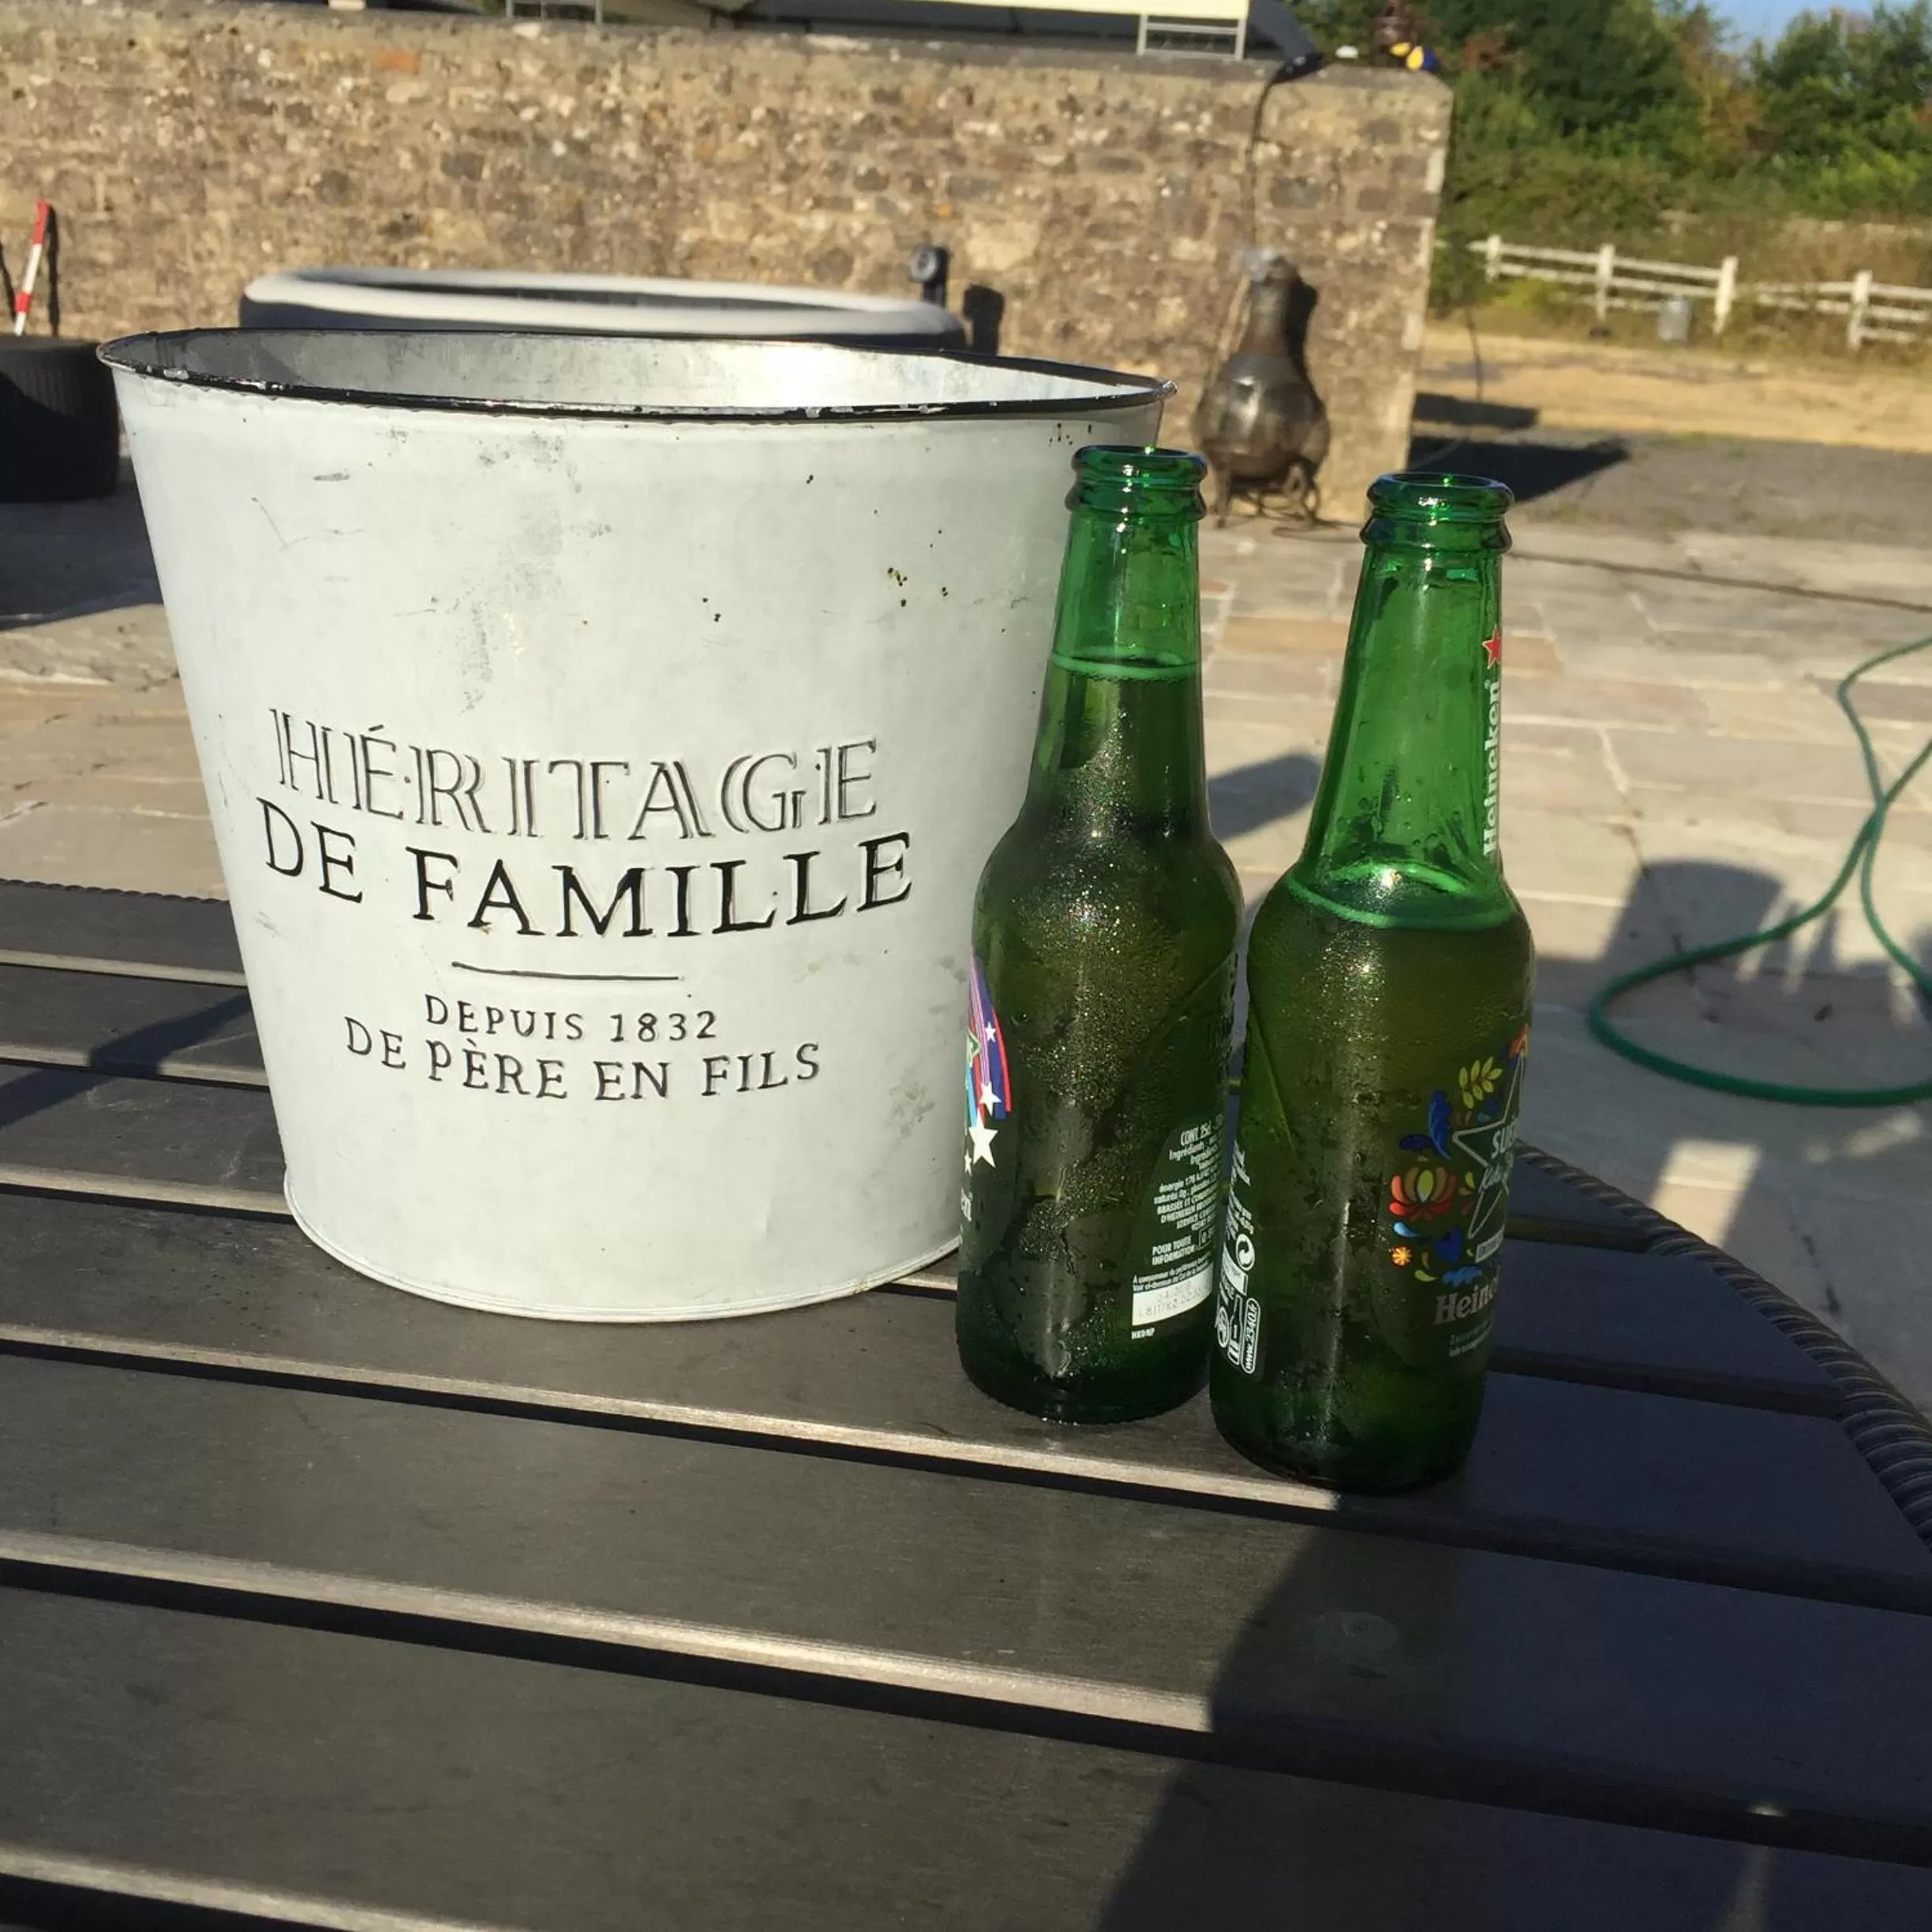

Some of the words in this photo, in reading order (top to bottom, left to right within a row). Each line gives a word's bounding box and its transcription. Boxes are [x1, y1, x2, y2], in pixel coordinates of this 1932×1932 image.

[271, 708, 878, 840] HÉRITAGE
[1483, 680, 1500, 856] Heineken
[257, 797, 362, 904] DE
[405, 831, 913, 938] FAMILLE
[345, 1017, 406, 1071] DE
[427, 1039, 569, 1100] PÈRE
[594, 1061, 670, 1100] EN
[702, 1042, 821, 1096] FILS
[425, 994, 584, 1041] DEPUIS
[610, 1011, 717, 1042] 1832
